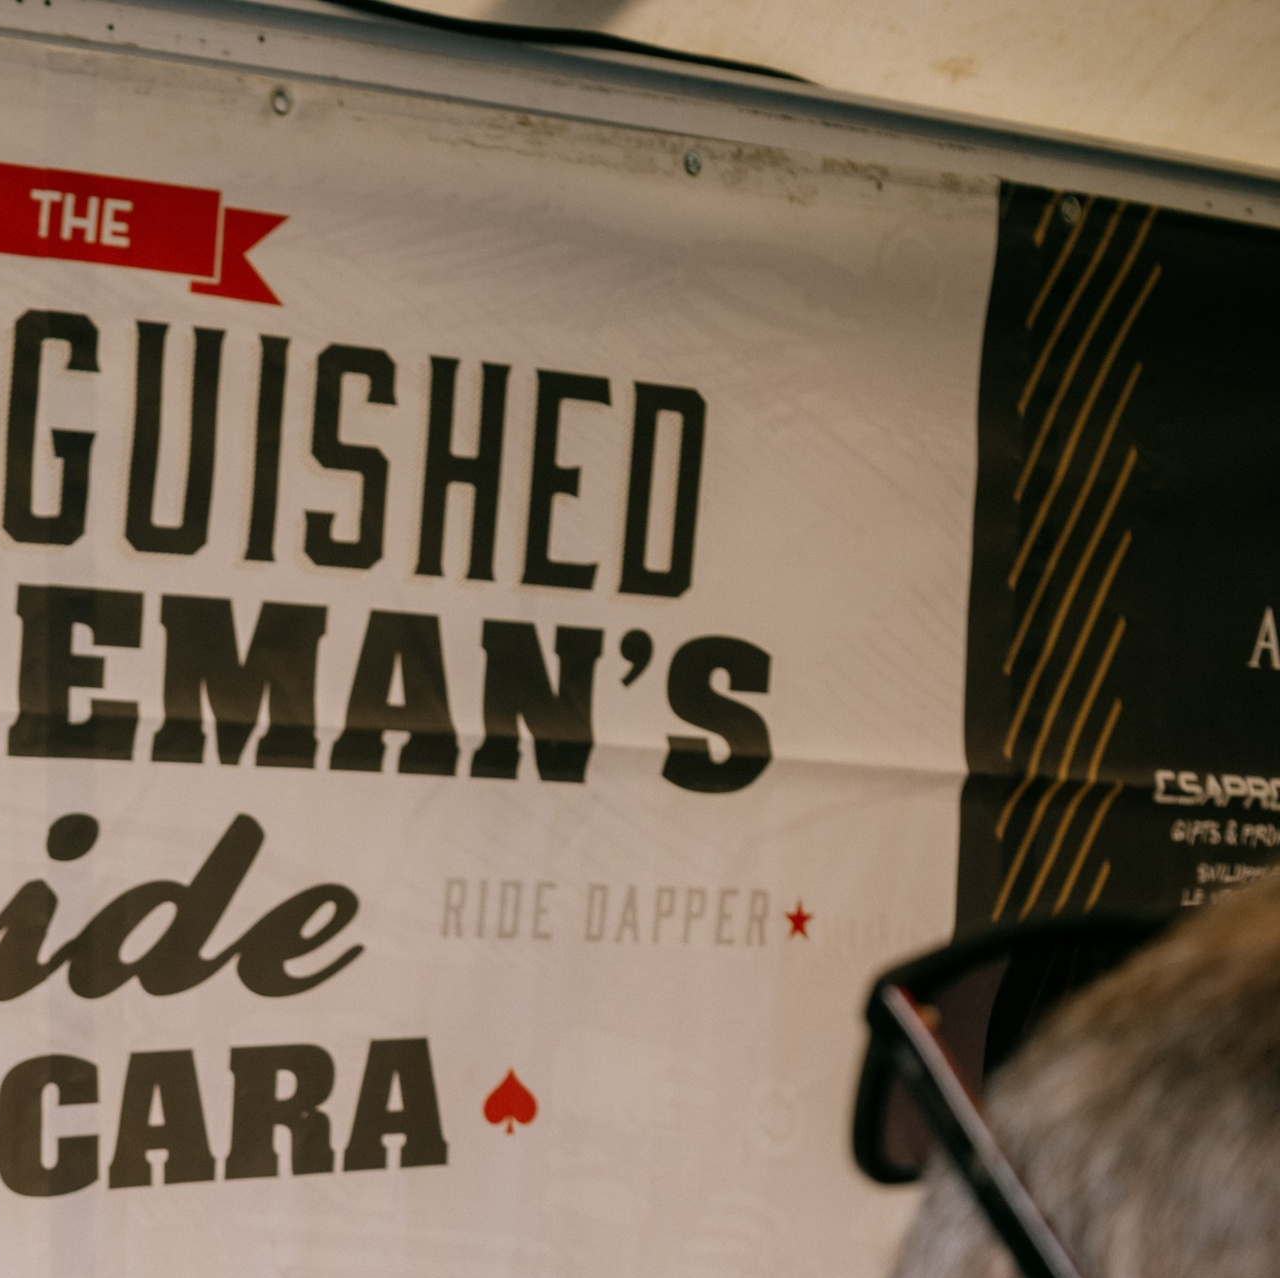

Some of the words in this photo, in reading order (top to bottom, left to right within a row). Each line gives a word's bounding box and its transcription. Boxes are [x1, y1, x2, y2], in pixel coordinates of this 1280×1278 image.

[29, 188, 135, 248] THE
[439, 875, 558, 944] RIDE
[584, 882, 772, 950] DAPPER
